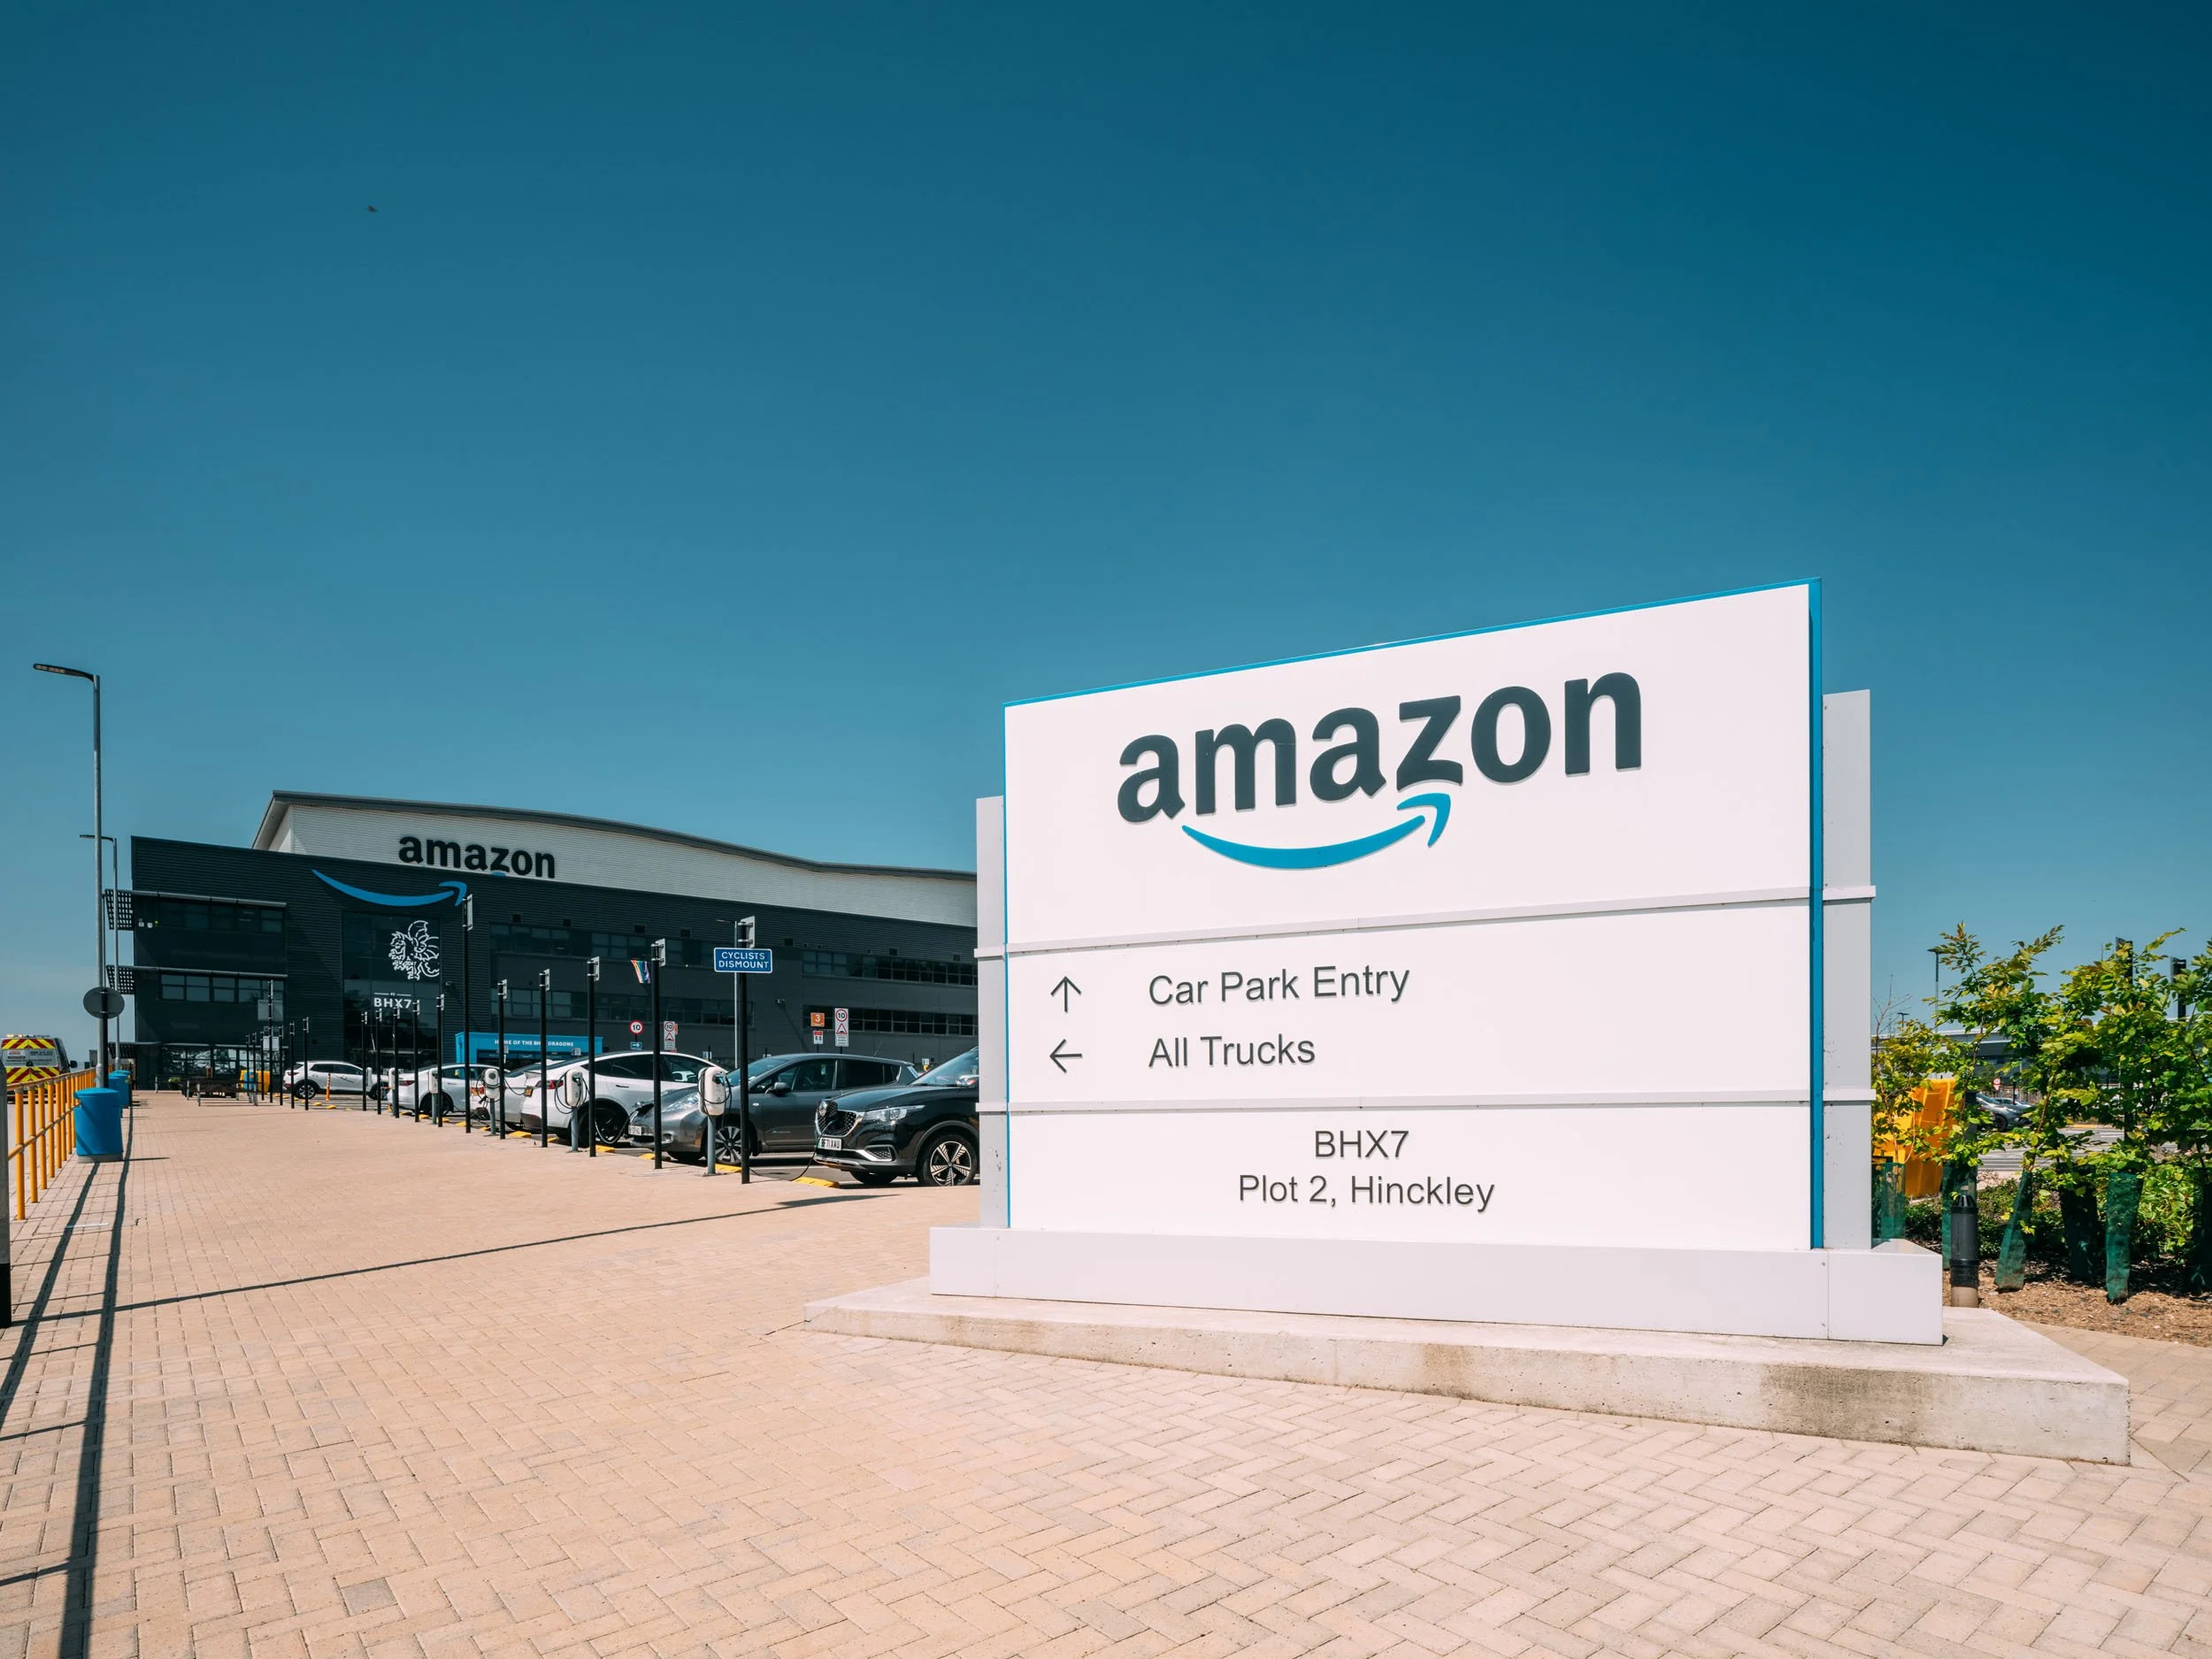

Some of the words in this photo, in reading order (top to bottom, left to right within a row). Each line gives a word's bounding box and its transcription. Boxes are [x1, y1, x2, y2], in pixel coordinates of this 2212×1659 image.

[1118, 672, 1643, 823] amazon
[398, 836, 556, 879] amazon
[718, 960, 769, 969] DISMOUNT
[721, 951, 765, 960] CYCLISTS
[1148, 975, 1210, 1005] Car
[1221, 968, 1300, 1002] Park
[1314, 964, 1410, 1002] Entry
[373, 997, 412, 1009] BHX7
[815, 1014, 821, 1023] 3
[1148, 1037, 1187, 1068] All
[1200, 1033, 1316, 1066] Trucks
[1315, 1130, 1409, 1158] BHX7
[1240, 1174, 1298, 1202] Plot
[1309, 1175, 1336, 1208] 2,
[1351, 1175, 1495, 1213] Hinckley
